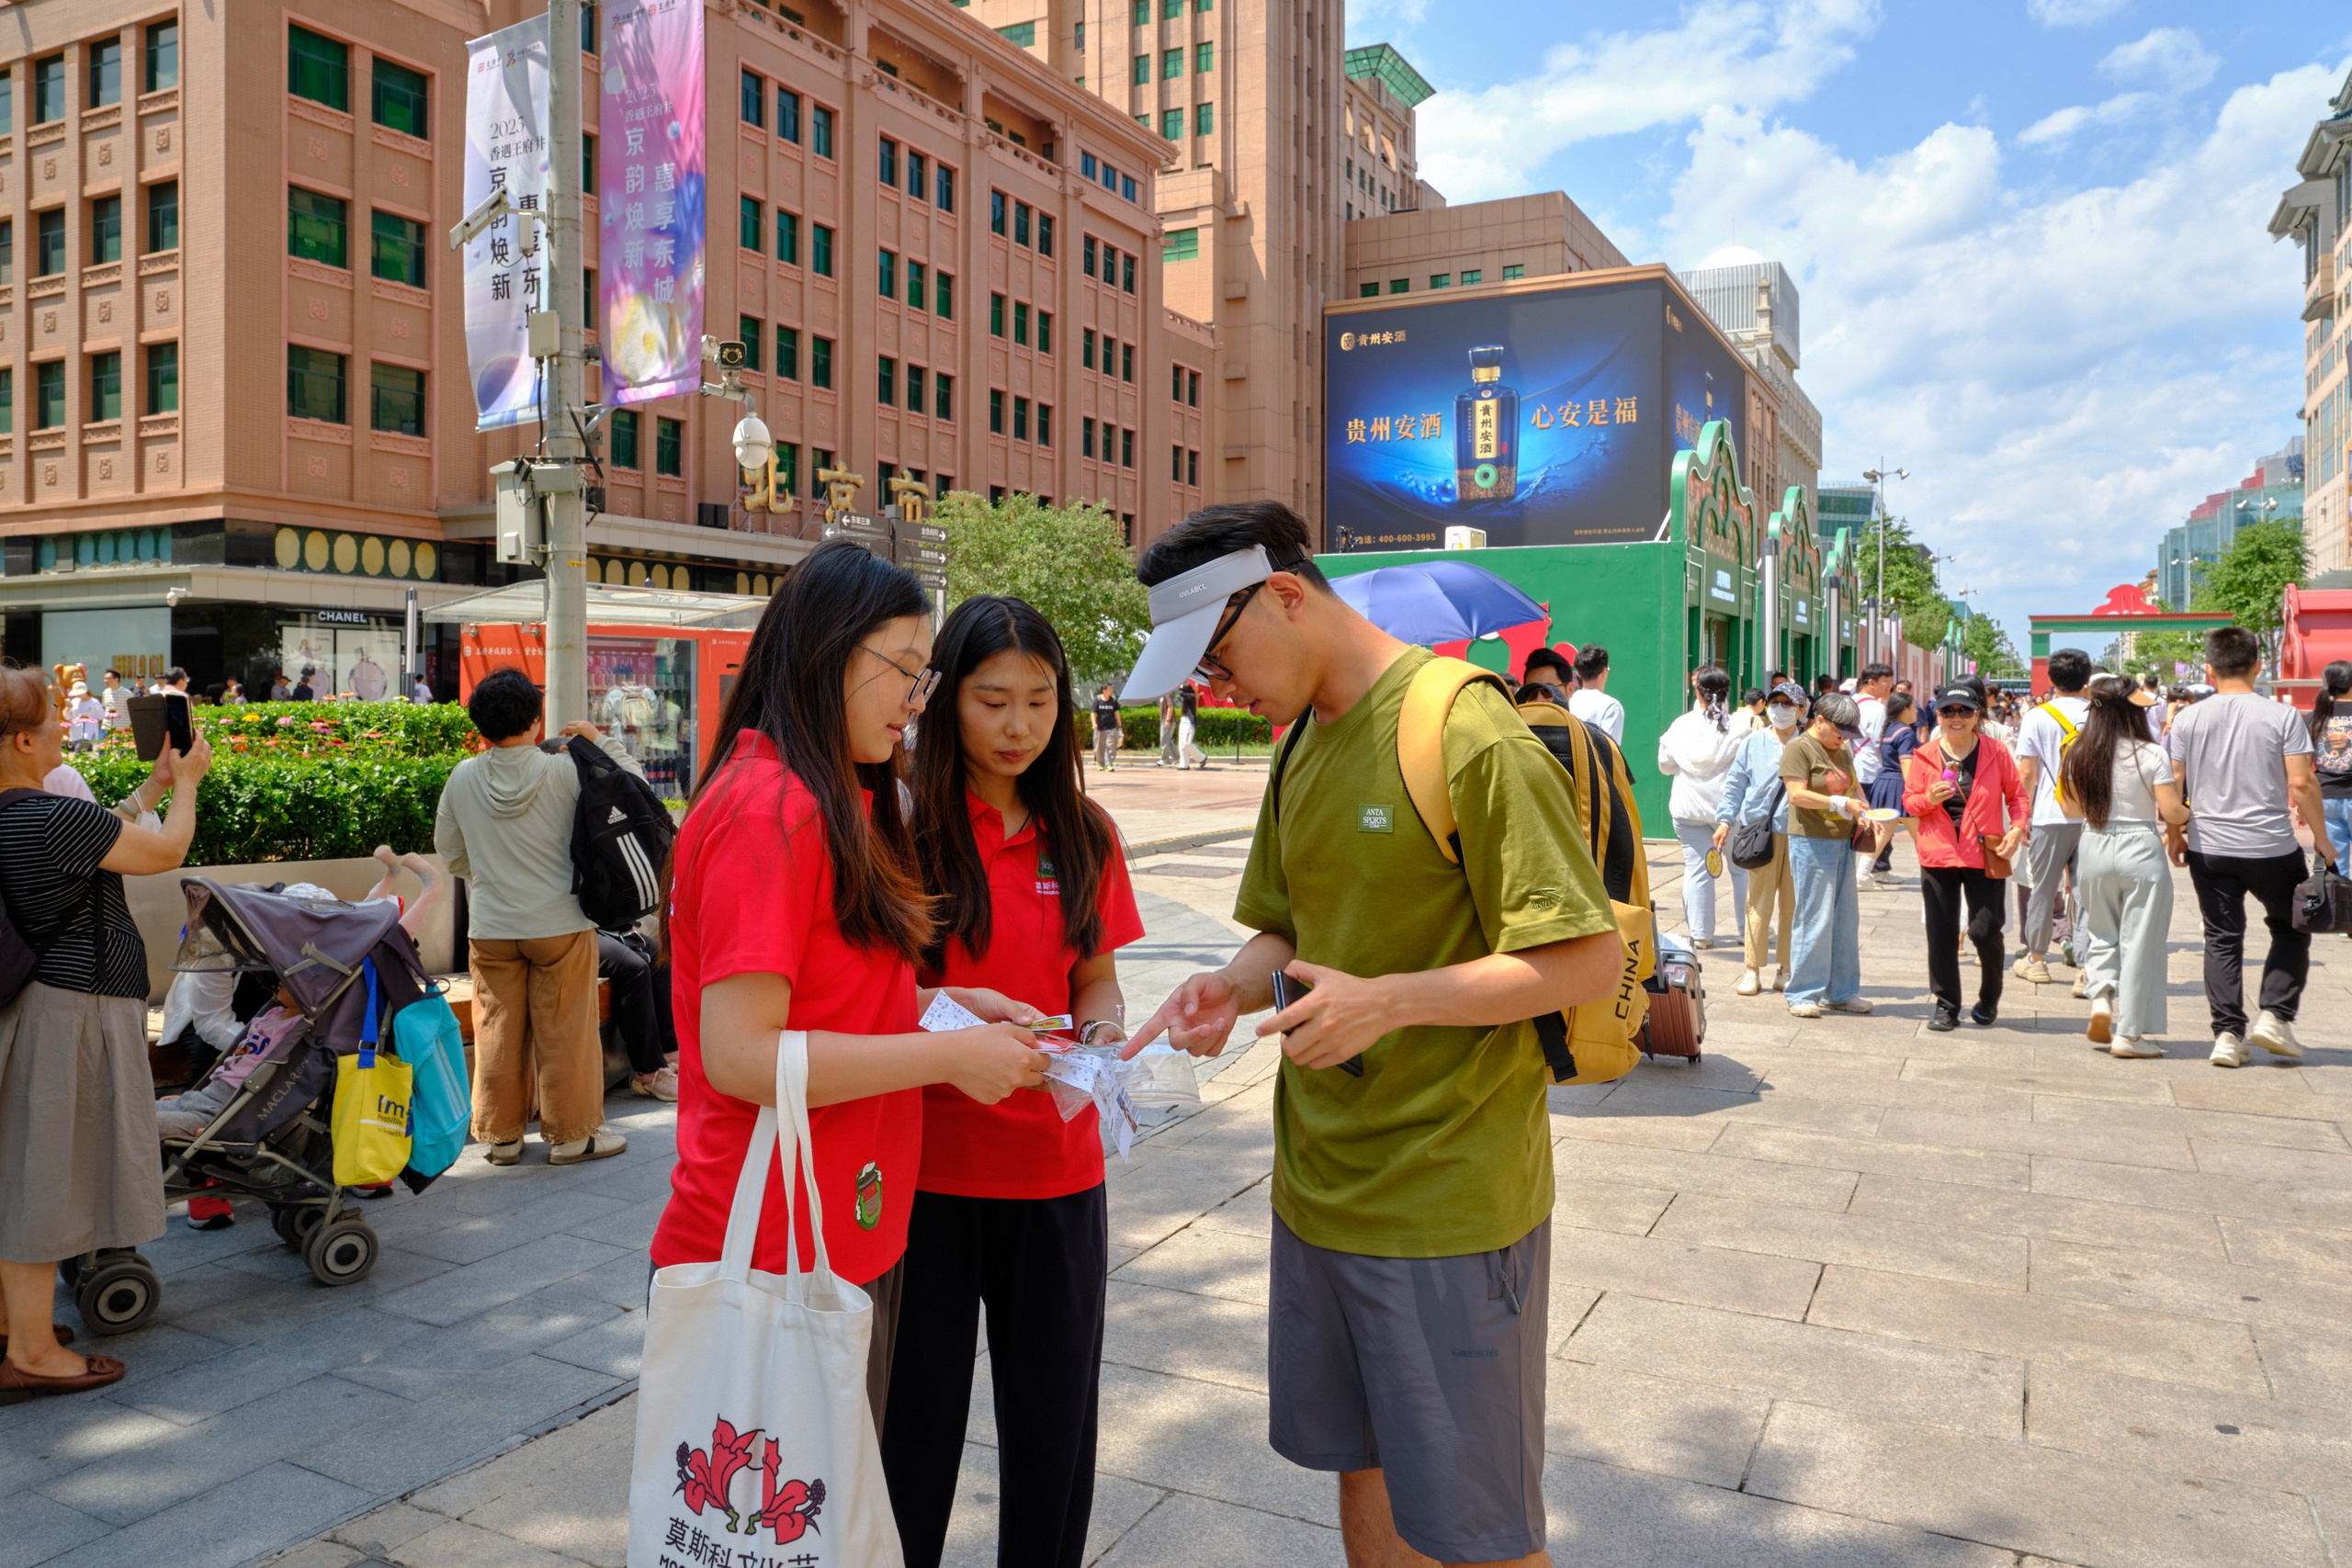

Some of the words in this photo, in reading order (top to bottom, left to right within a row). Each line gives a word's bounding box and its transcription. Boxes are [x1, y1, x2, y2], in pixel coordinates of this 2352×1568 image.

[626, 84, 656, 103] 2025
[490, 115, 525, 140] 2025
[489, 135, 546, 162] 香遇王府井
[625, 127, 645, 268] 京韵焕新
[654, 163, 675, 304] 惠享东城
[1531, 396, 1637, 429] 心安是福
[1346, 412, 1442, 445] 贵州安酒
[318, 612, 367, 623] CHANEL
[1363, 817, 1387, 825] SPORTS
[1615, 939, 1640, 1020] CHINA
[257, 1058, 309, 1121] MACLAREN
[378, 1113, 403, 1126] Possible
